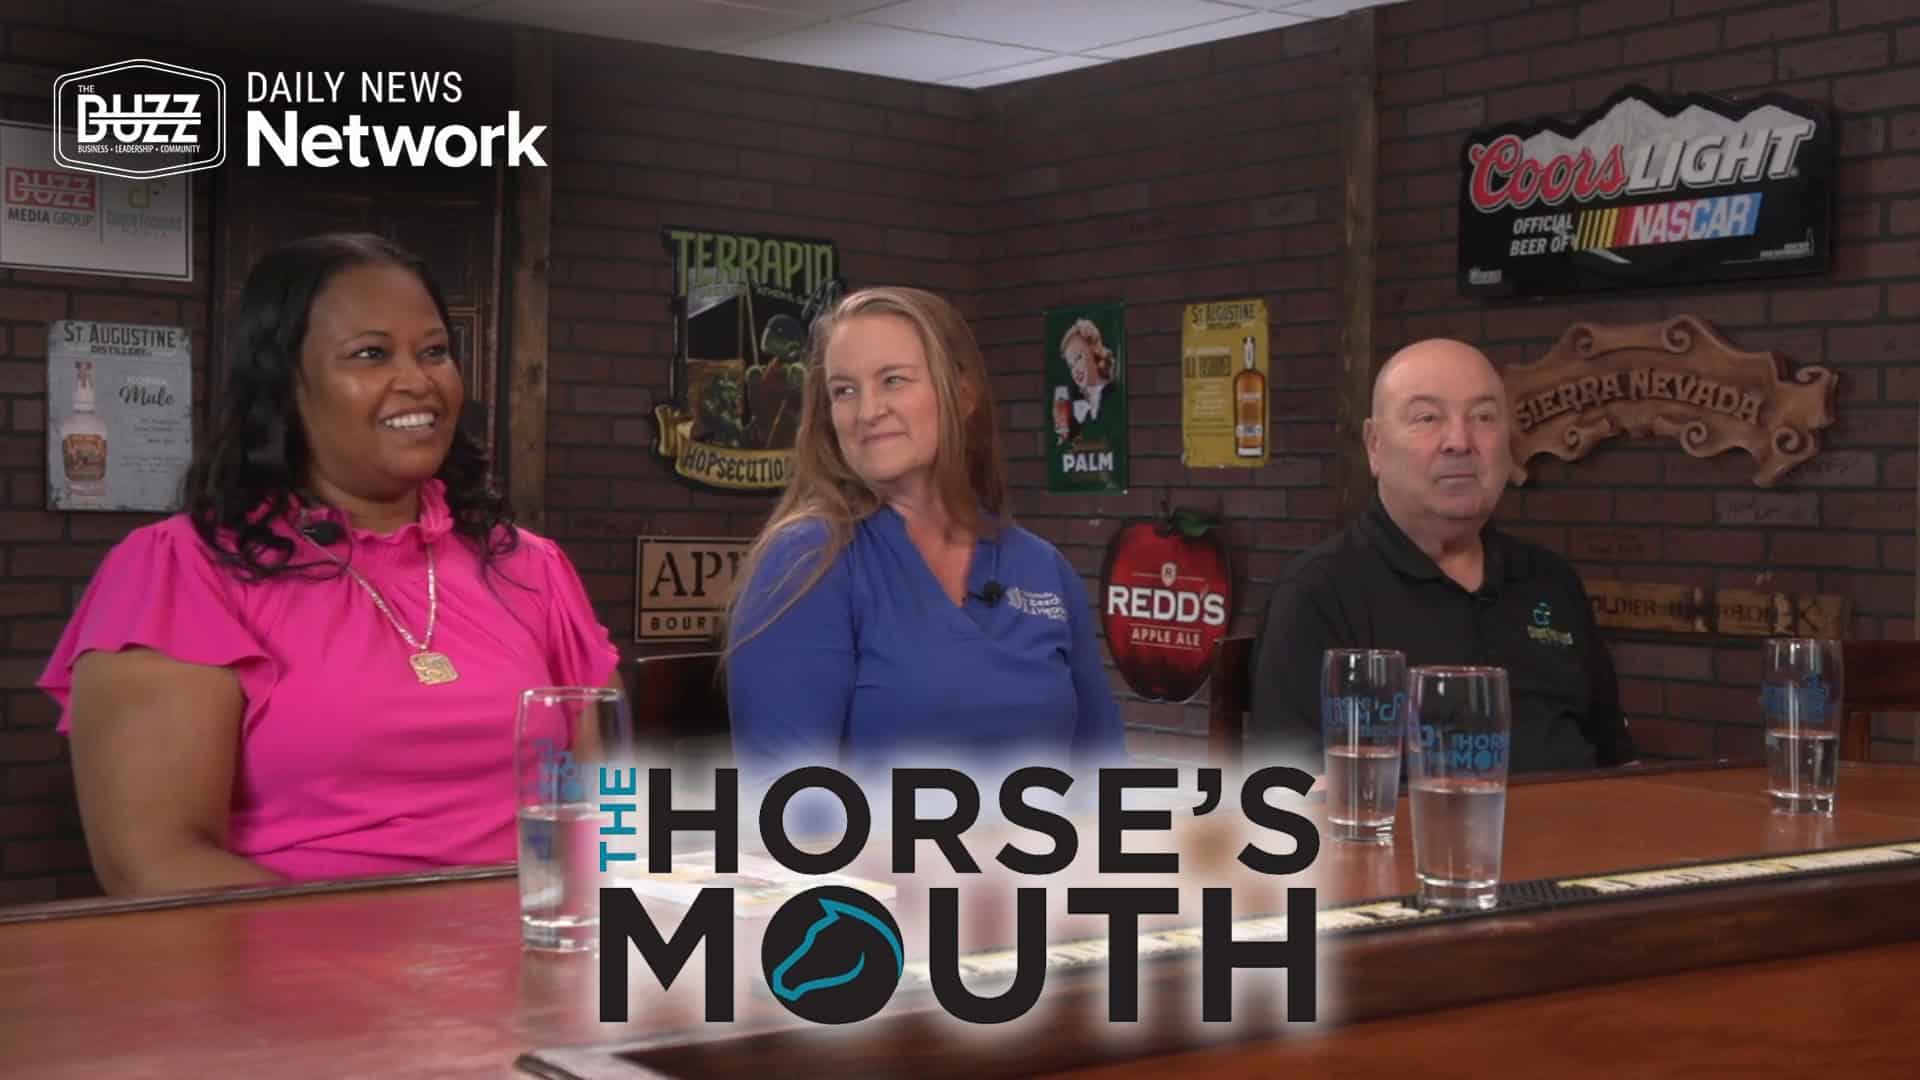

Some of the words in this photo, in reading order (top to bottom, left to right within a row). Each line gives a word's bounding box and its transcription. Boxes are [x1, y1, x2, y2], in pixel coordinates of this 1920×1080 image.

[1469, 134, 1630, 213] Coors
[1626, 119, 1815, 195] LIGHT
[9, 171, 90, 208] BUZZ
[8, 208, 50, 224] MEDIA
[1513, 212, 1573, 235] OFFICIAL
[1628, 194, 1752, 245] NASCAR
[1510, 238, 1547, 256] BEER
[1551, 234, 1571, 254] OF
[671, 230, 833, 297] TERRAPIN
[90, 325, 176, 348] AUGUSTINE
[1515, 371, 1624, 432] SIERRA
[1629, 368, 1763, 425] NEVADA
[1062, 452, 1114, 473] PALM
[1132, 627, 1171, 644] APPLE
[1176, 631, 1201, 647] ALE
